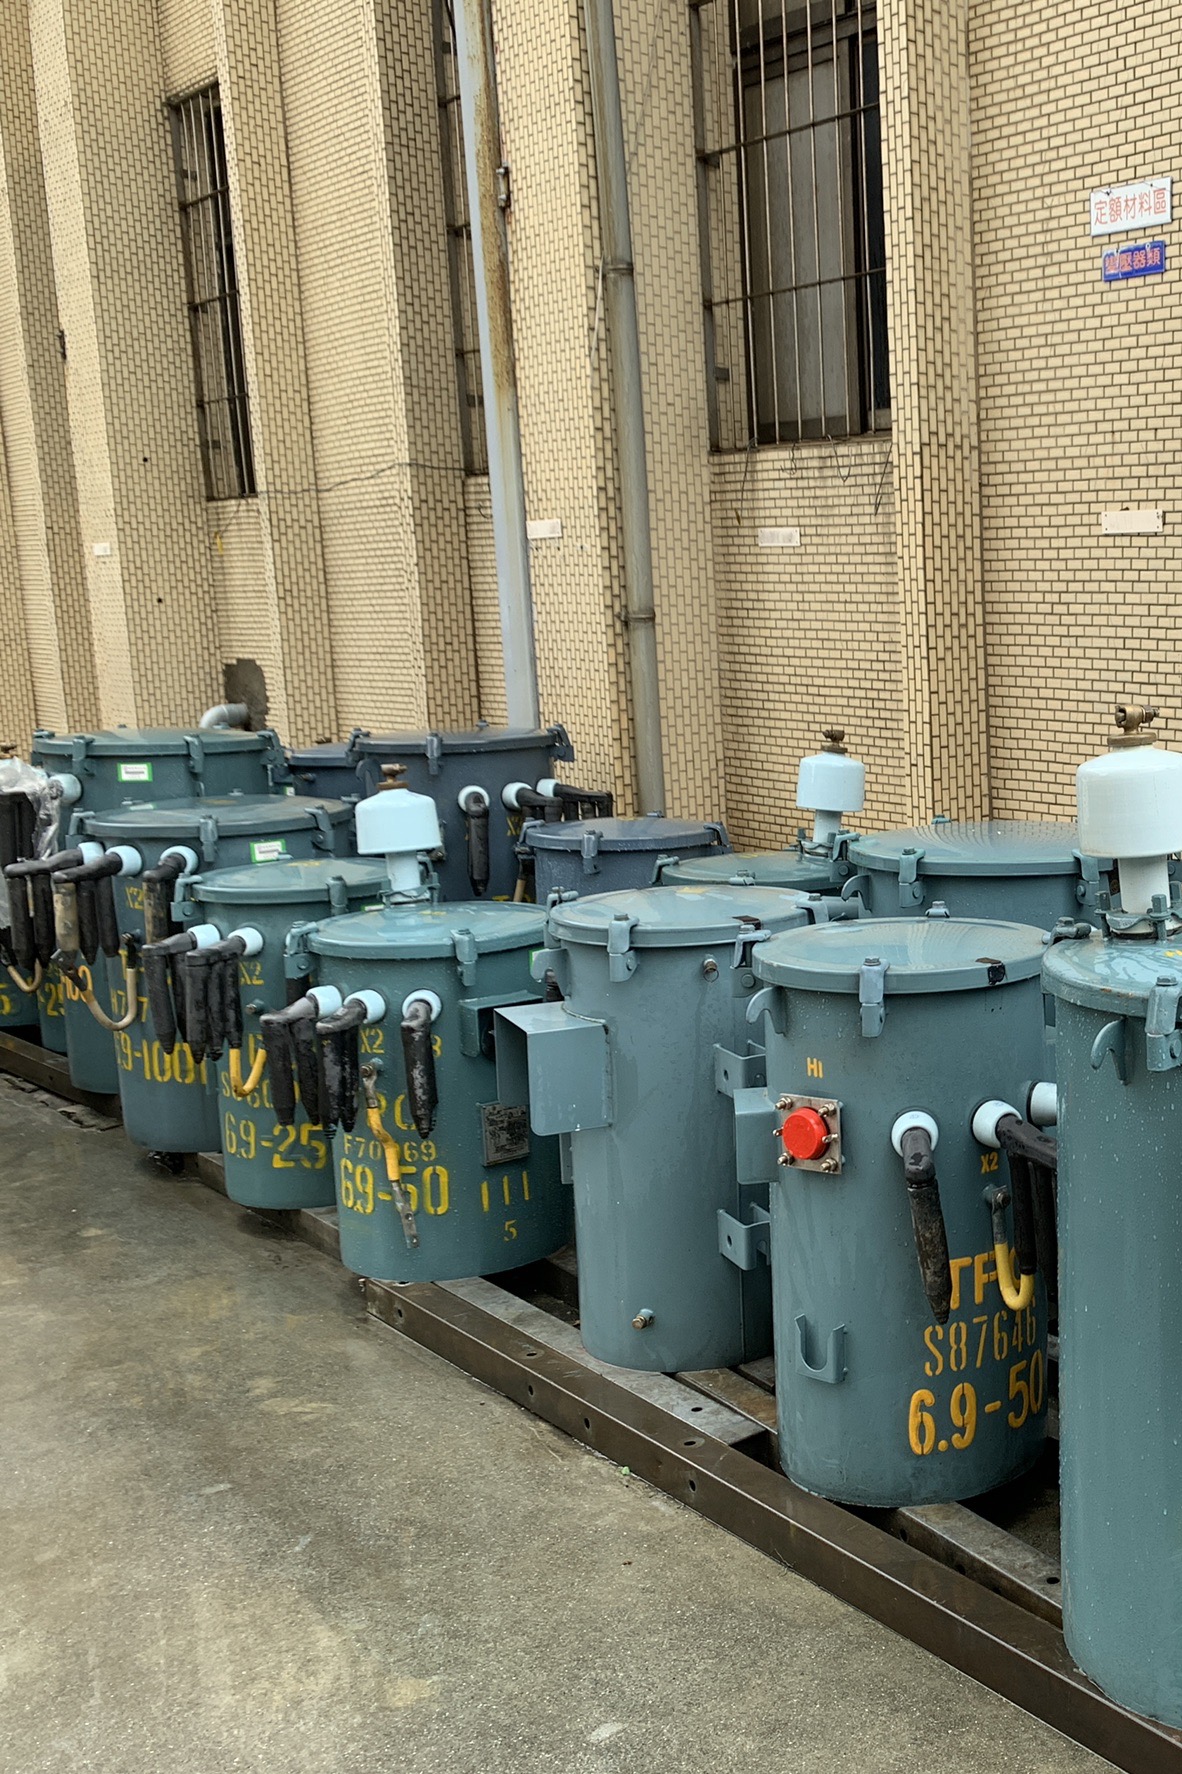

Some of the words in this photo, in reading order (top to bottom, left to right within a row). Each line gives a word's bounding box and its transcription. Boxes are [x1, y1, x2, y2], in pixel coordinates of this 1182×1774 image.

[1094, 187, 1167, 226] 定額材料區
[360, 1028, 385, 1054] X2
[343, 1134, 437, 1163] F7069
[980, 1151, 999, 1174] X2
[908, 1348, 1044, 1456] 6.9-50
